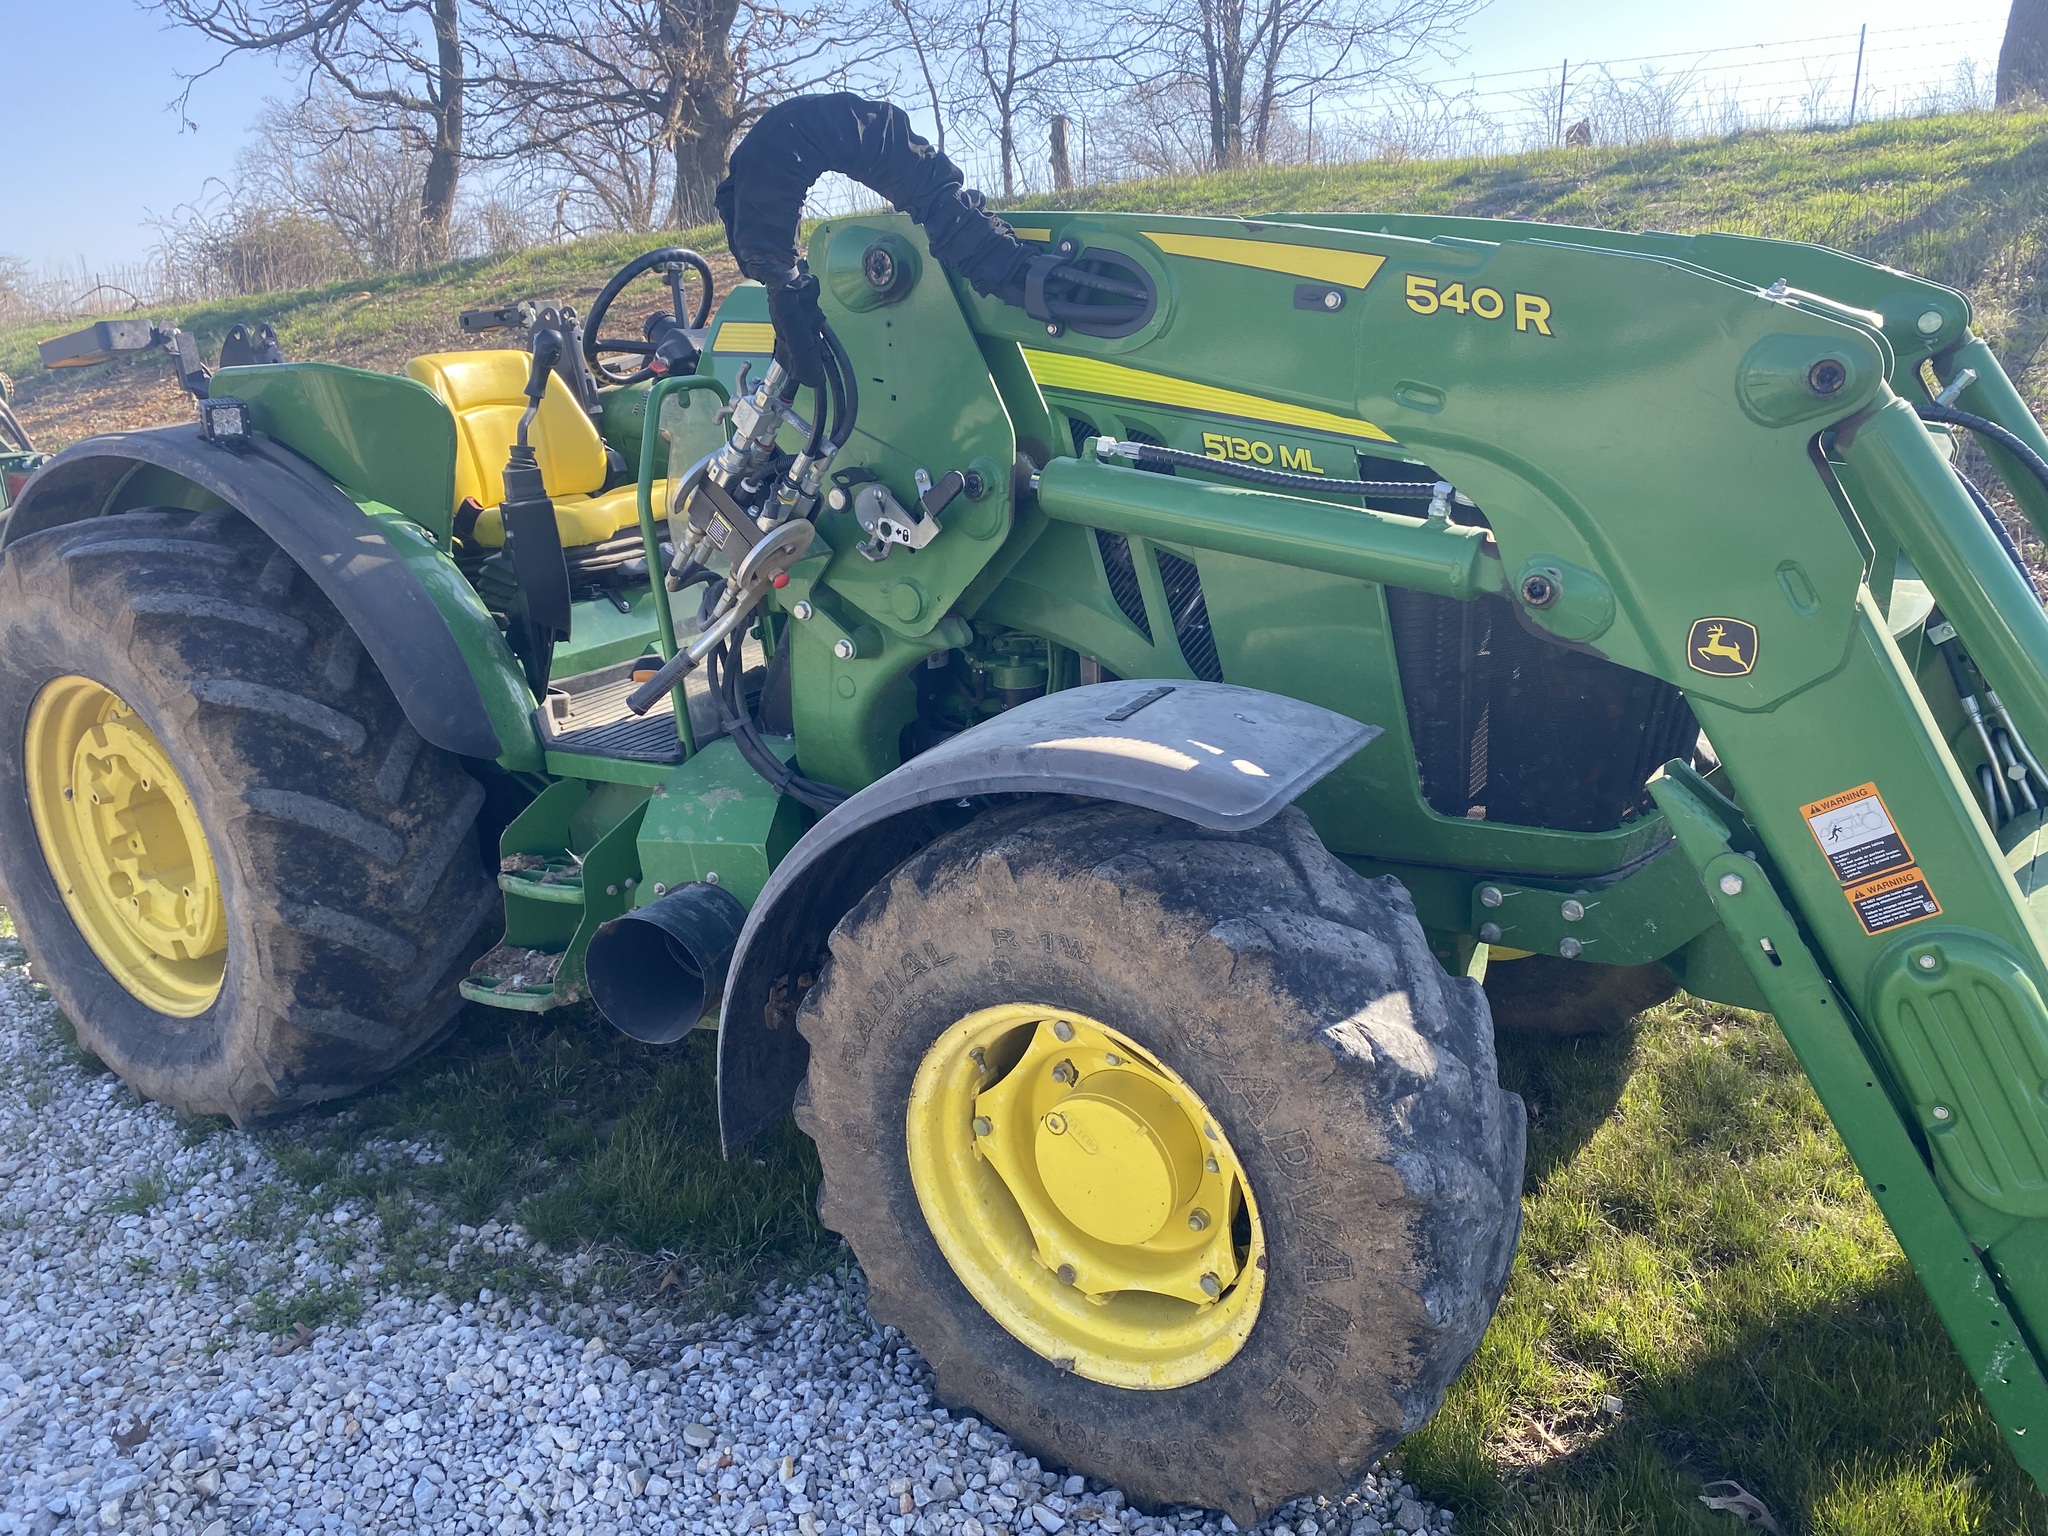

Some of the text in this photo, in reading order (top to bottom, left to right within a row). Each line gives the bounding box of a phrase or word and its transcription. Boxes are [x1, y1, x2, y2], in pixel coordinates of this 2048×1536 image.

[1405, 274, 1556, 338] 540 R
[1202, 432, 1325, 474] 5130 ML
[1820, 788, 1868, 810] WARNING
[1866, 873, 1915, 893] WARNING
[842, 939, 958, 1079] RADIAL
[1218, 1073, 1355, 1429] ADVANCE
